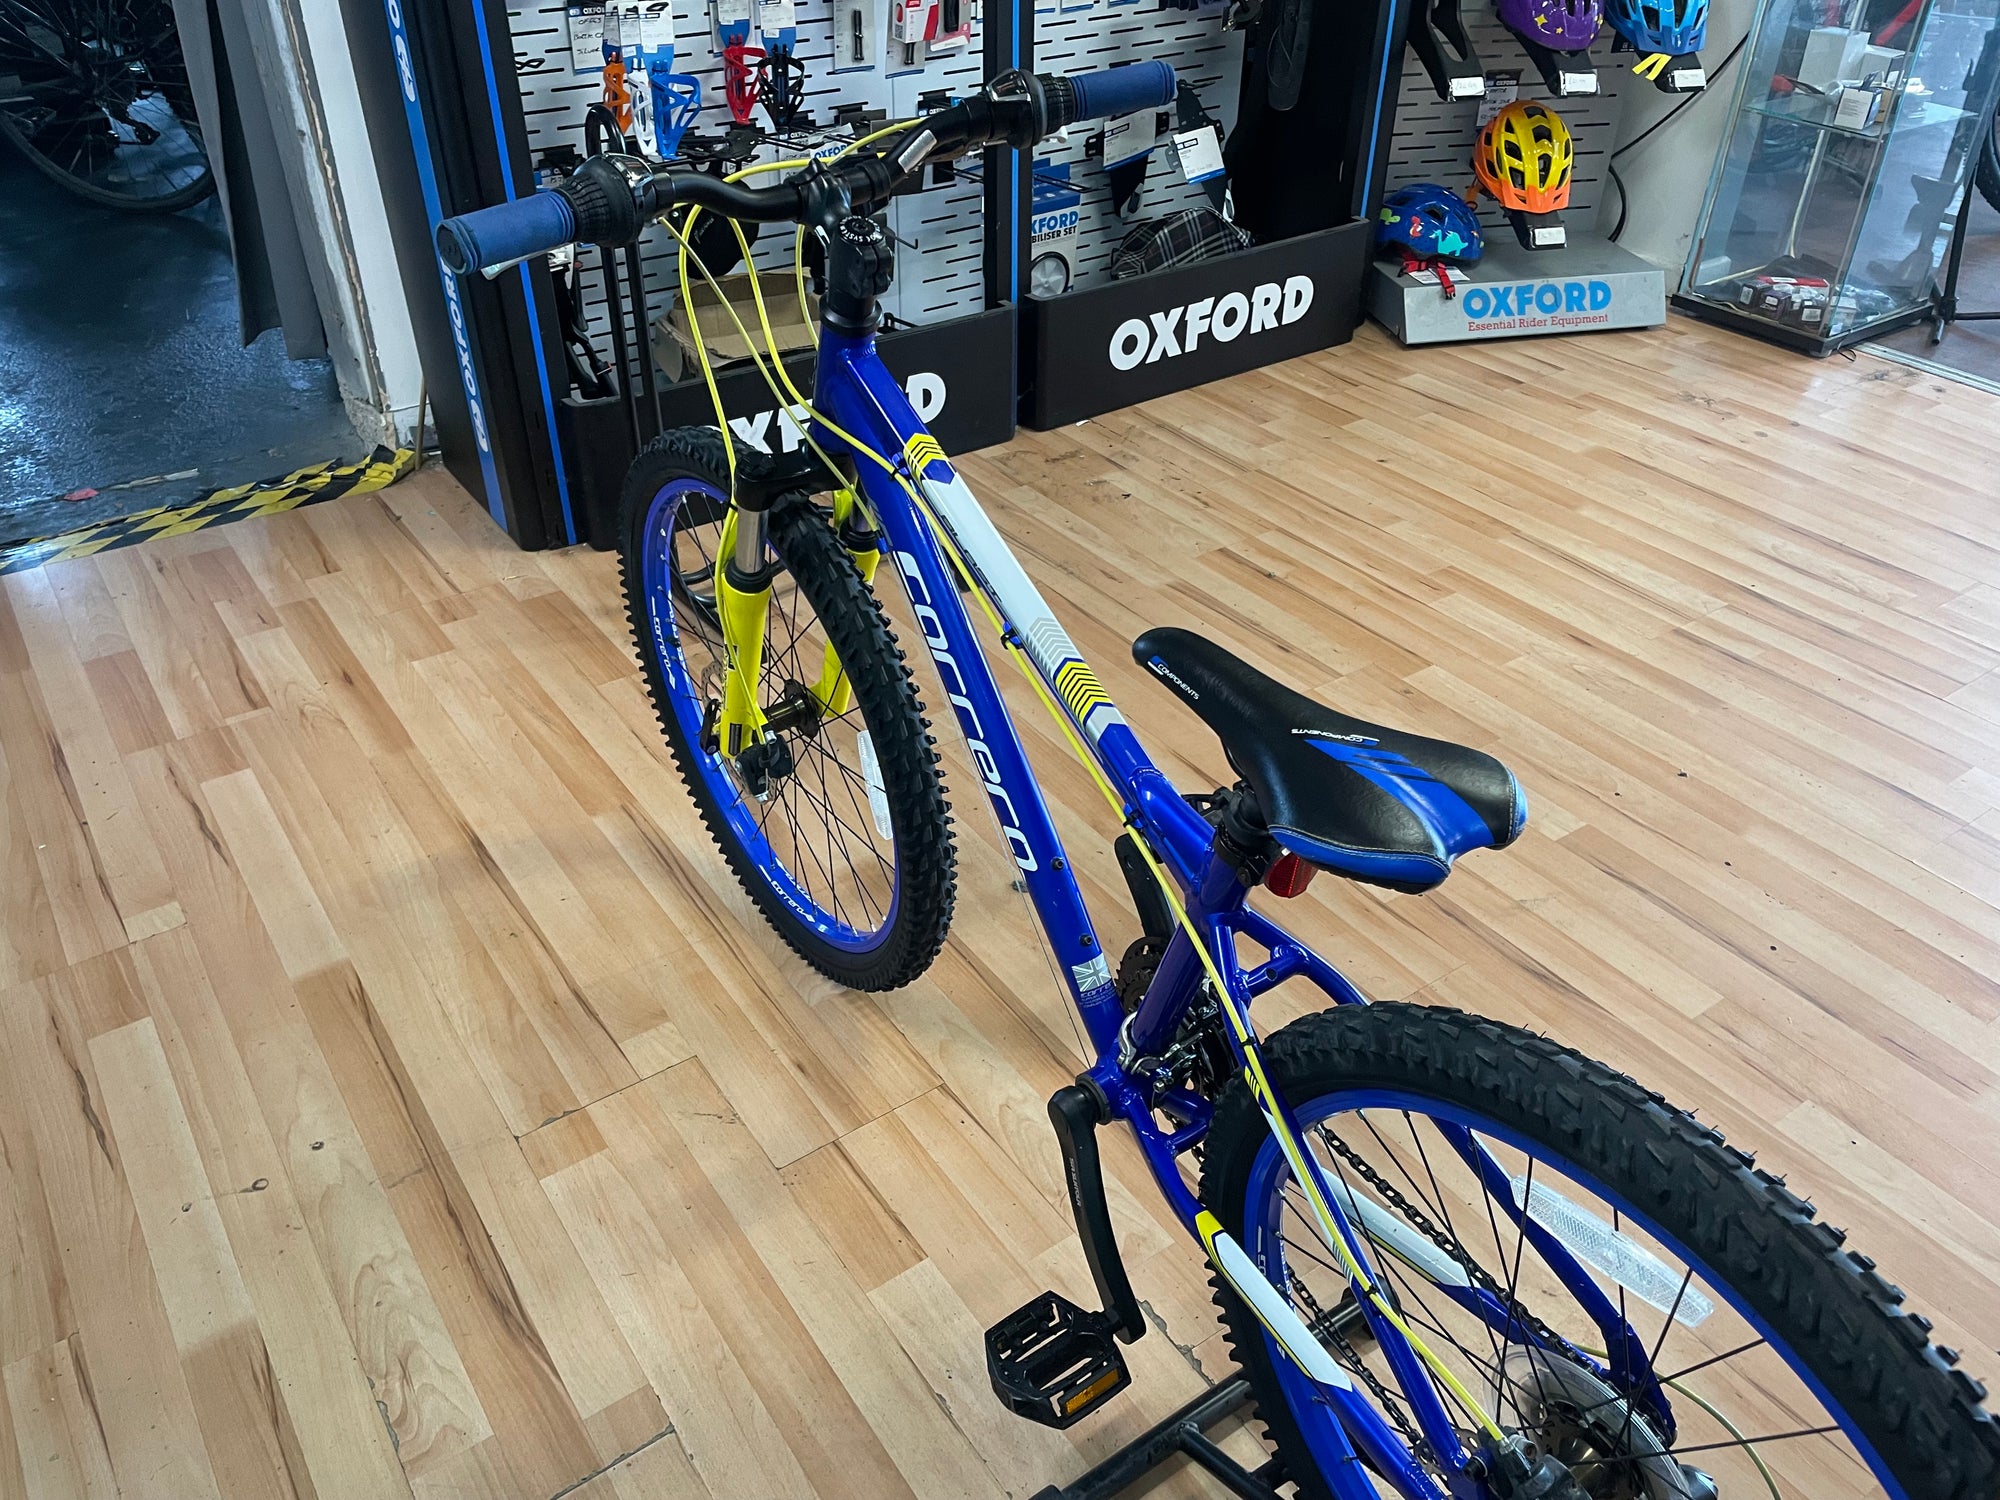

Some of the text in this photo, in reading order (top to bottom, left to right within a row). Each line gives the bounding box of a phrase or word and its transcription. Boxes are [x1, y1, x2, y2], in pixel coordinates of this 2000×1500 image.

[583, 7, 605, 15] OXFO
[814, 144, 848, 159] OXFOR
[1063, 225, 1077, 236] SET
[1462, 280, 1612, 319] OXFORD
[1108, 275, 1314, 371] OXFORD
[1468, 313, 1609, 332] Essential Rider Equipment
[1157, 663, 1200, 700] COMPONENTS
[893, 550, 1038, 877] carrera
[1291, 728, 1363, 743] COMPONENTS
